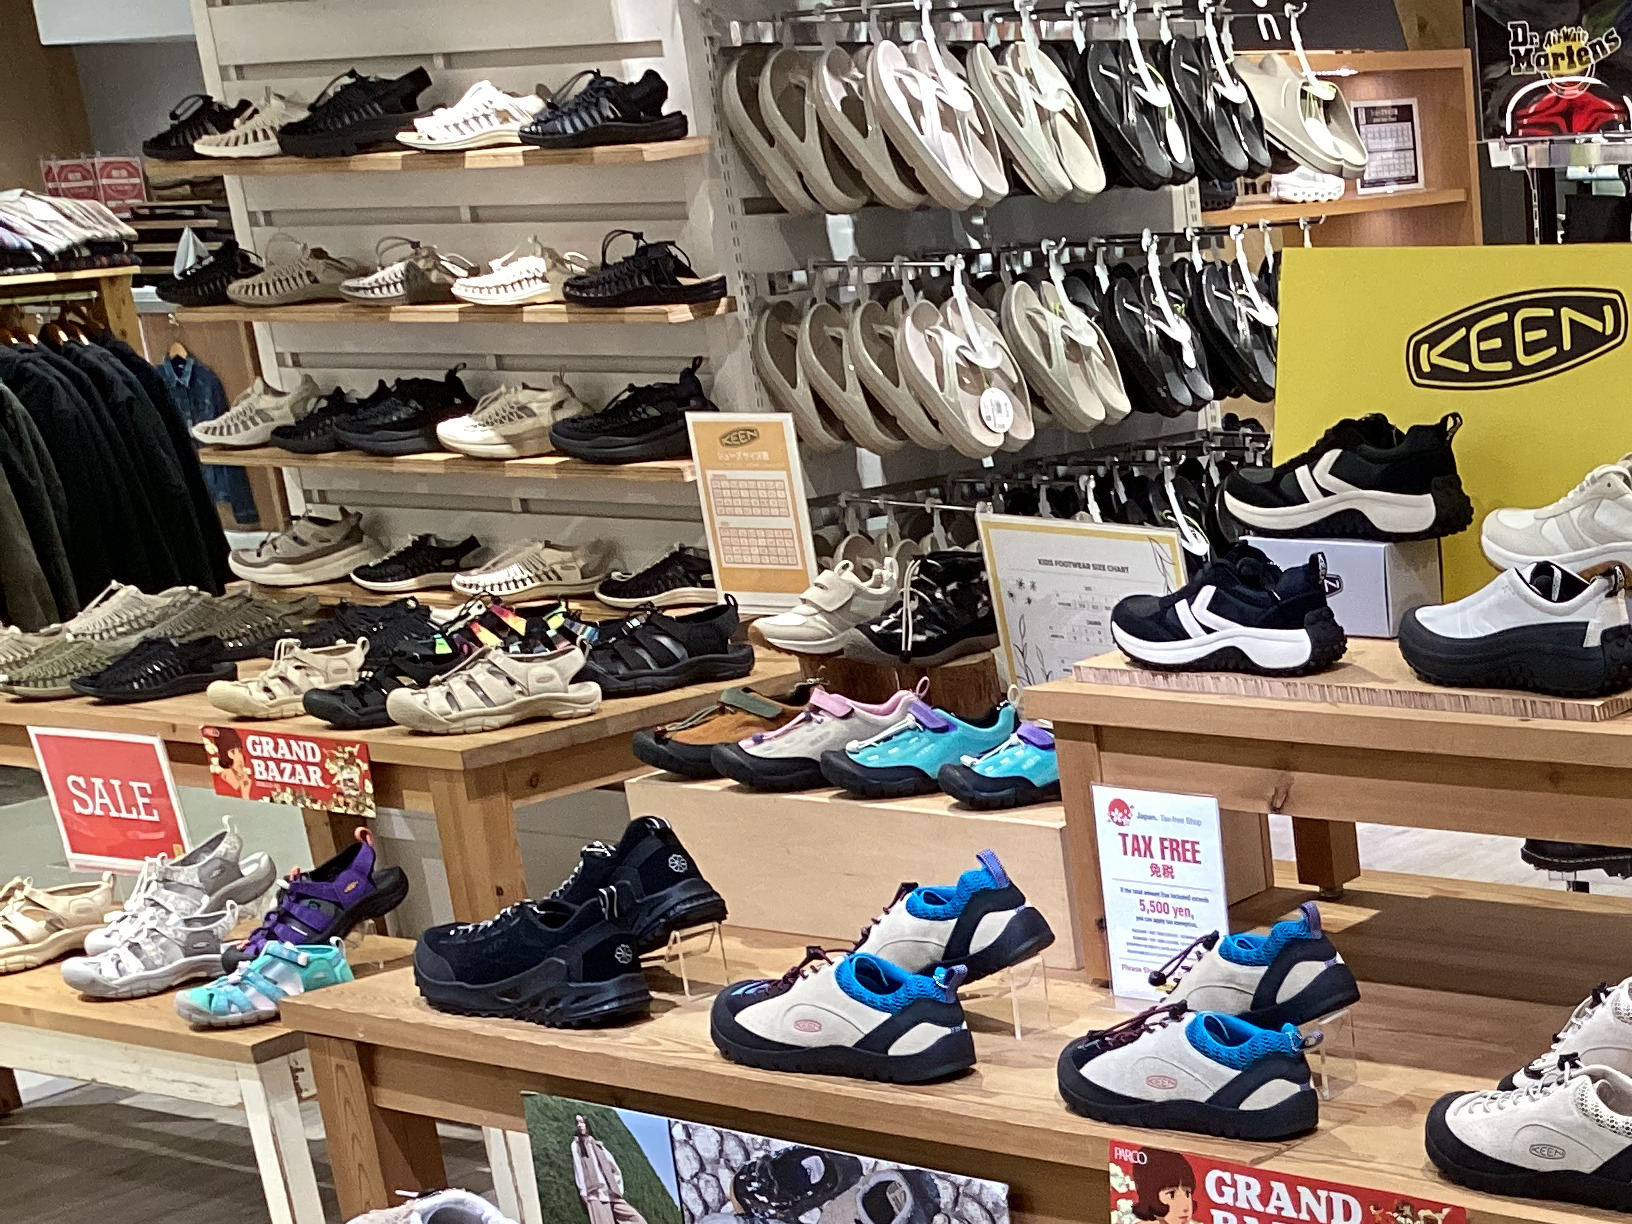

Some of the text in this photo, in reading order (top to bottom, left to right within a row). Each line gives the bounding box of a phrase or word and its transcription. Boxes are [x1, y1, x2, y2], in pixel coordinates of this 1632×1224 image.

[1510, 27, 1621, 75] Martens
[1420, 304, 1614, 372] KEEN
[722, 429, 758, 446] KEEN
[246, 735, 321, 763] GRAND
[251, 759, 325, 787] BAZAR
[66, 775, 160, 822] SALE
[1118, 832, 1202, 864] TAX FREE
[1150, 863, 1174, 879] 免税
[1139, 899, 1194, 920] 5,500 yen,
[1114, 1146, 1147, 1165] PARCO
